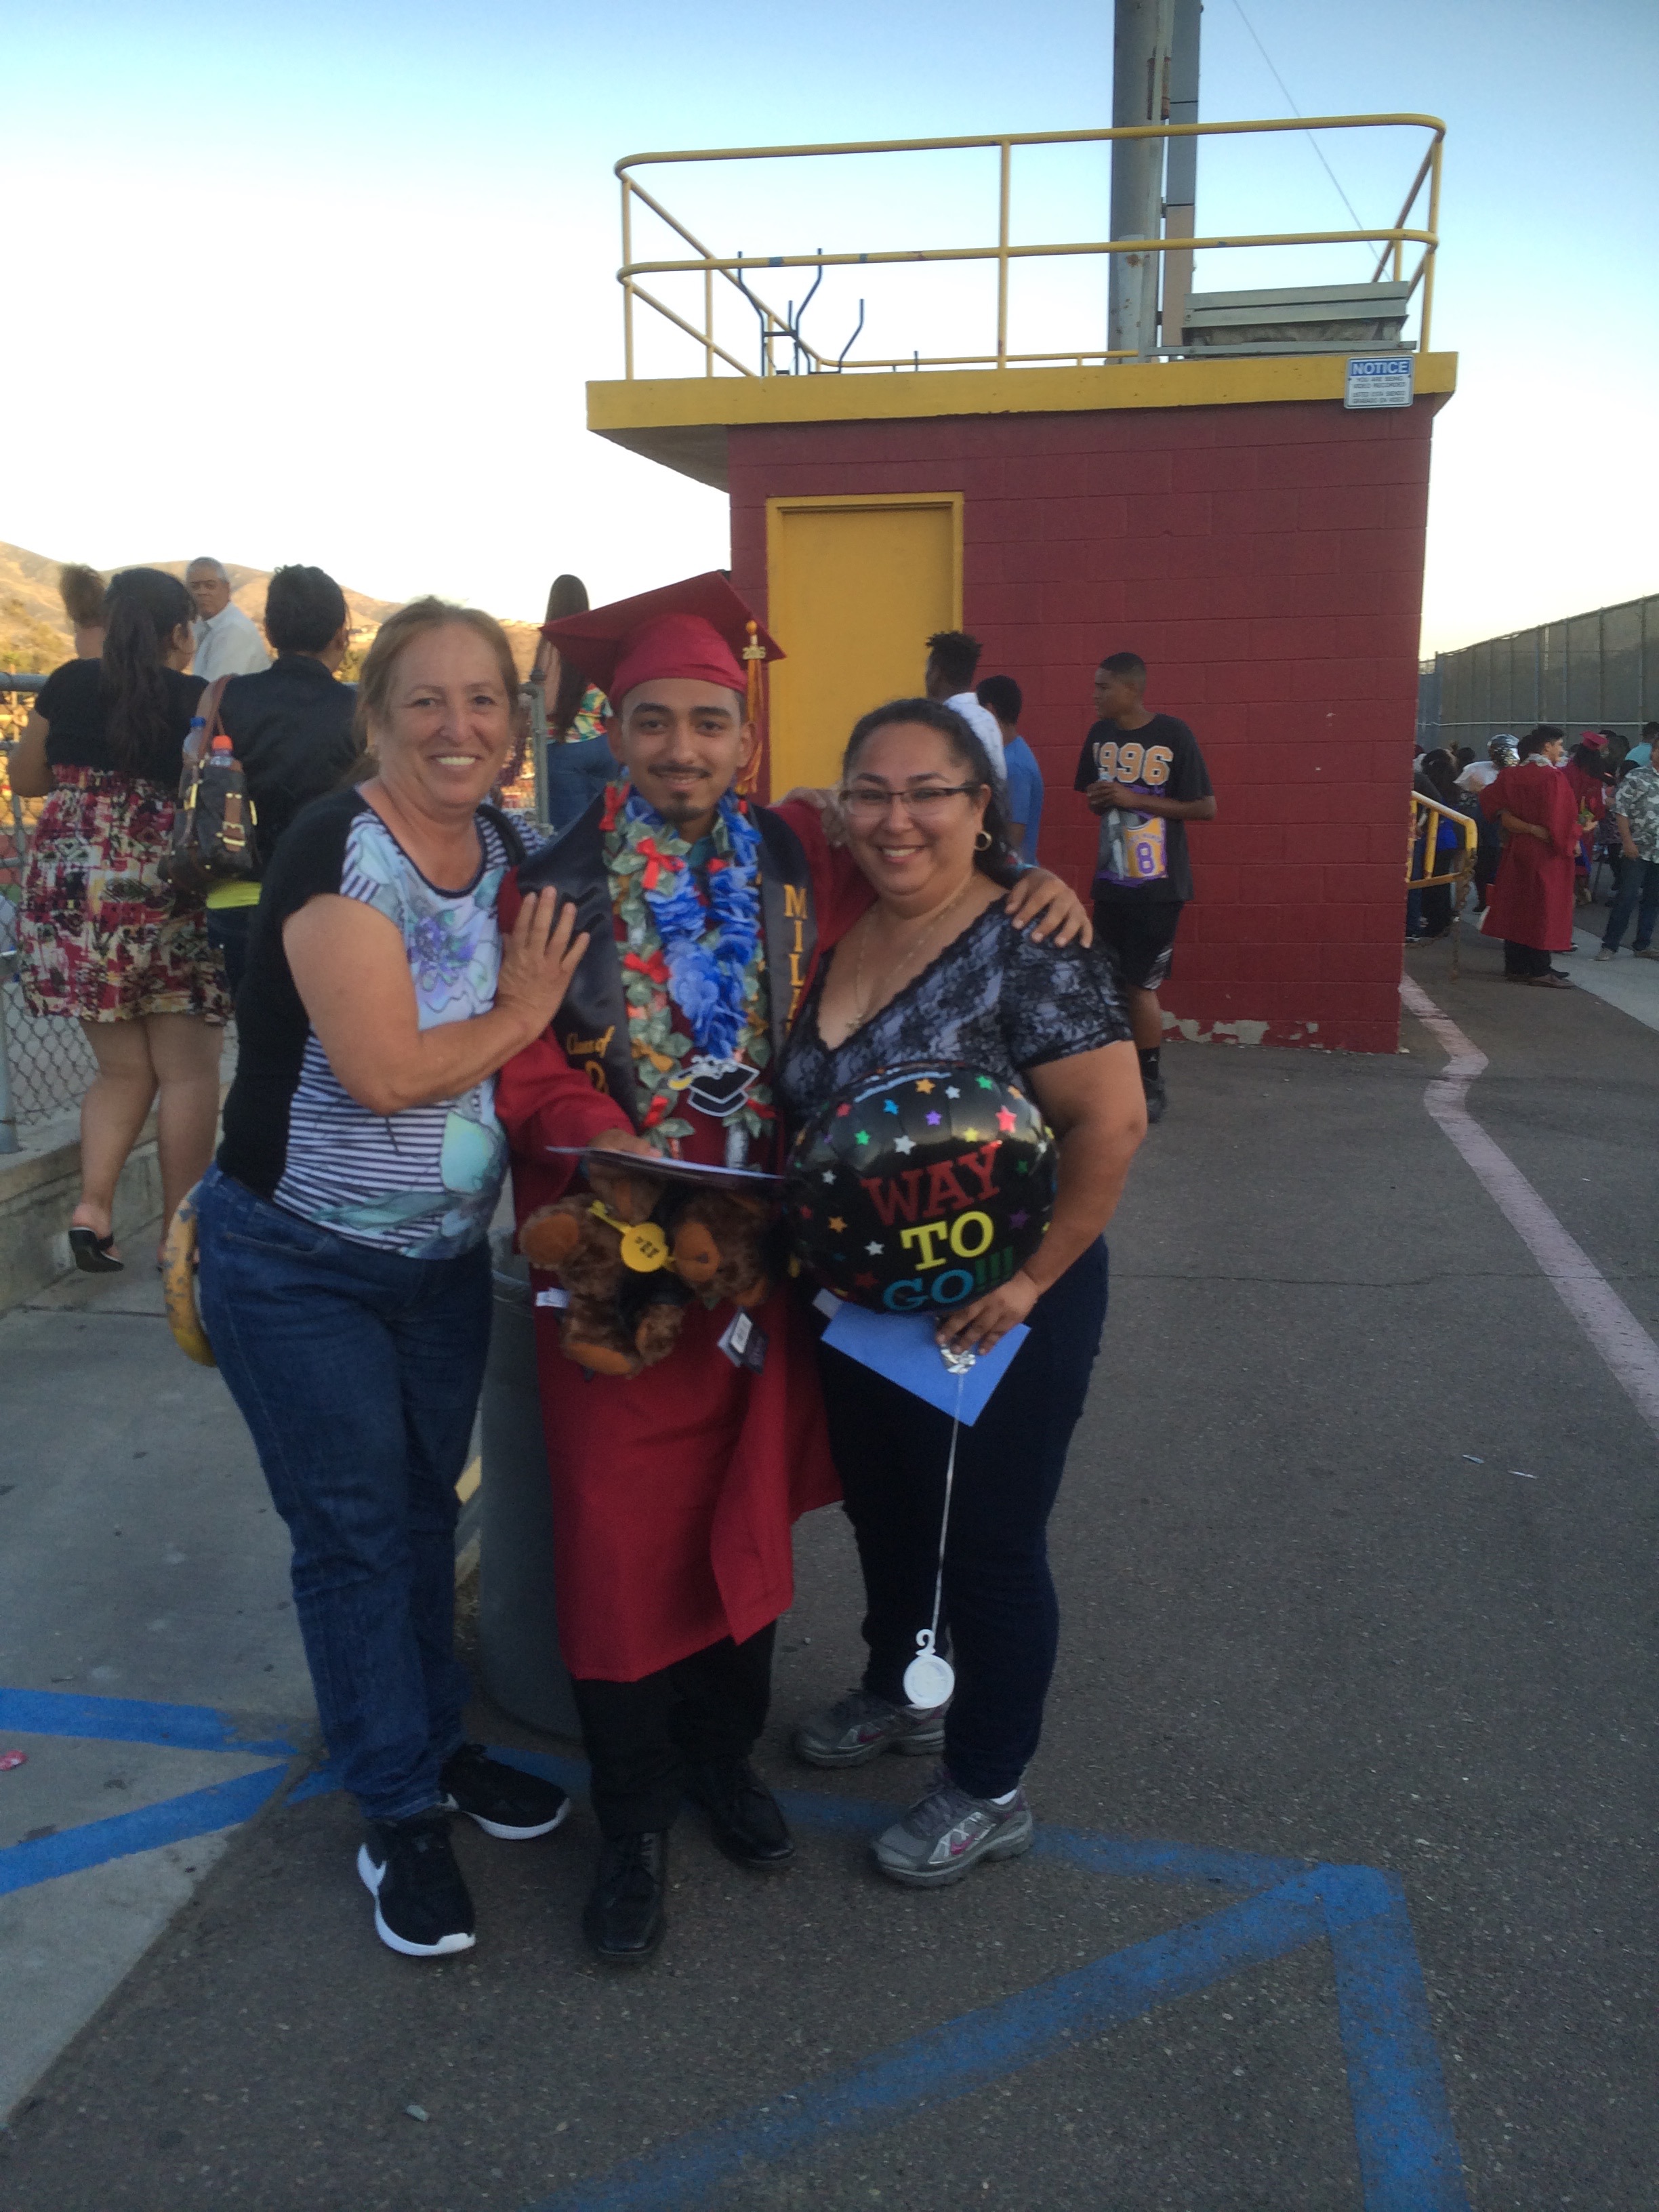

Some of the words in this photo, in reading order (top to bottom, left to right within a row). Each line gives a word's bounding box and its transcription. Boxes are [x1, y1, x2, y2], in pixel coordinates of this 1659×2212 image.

[1353, 361, 1409, 375] NOTICE
[1136, 842, 1155, 876] 8
[859, 1140, 1003, 1226] WAY
[900, 1210, 995, 1272] TO
